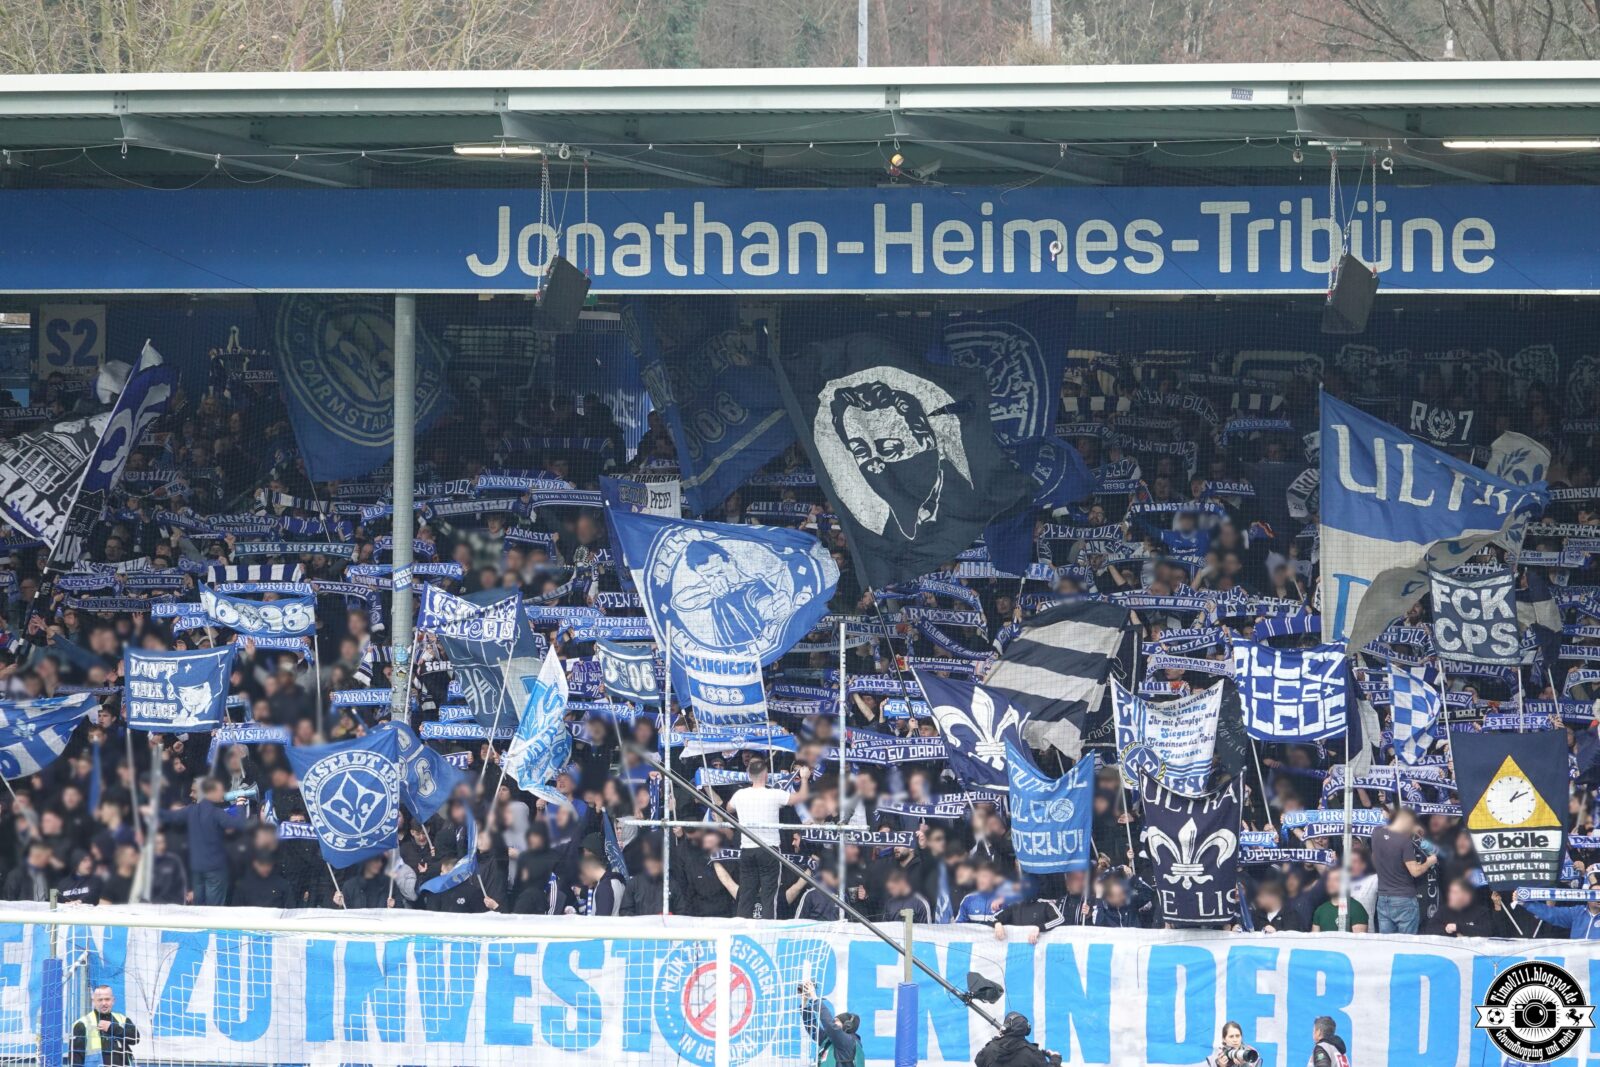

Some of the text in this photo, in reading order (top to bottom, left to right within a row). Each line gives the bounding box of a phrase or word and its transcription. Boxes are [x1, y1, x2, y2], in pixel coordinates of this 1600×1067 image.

[466, 197, 1496, 277] Jonathan-Heimes-Tribüne
[46, 318, 99, 366] S2
[1144, 502, 1199, 513] DARMSTADT
[1204, 503, 1215, 512] 98
[244, 543, 281, 553] USUAL
[147, 577, 163, 585] DIE
[1161, 598, 1175, 607] AM
[1431, 579, 1516, 621] FCK
[1435, 617, 1520, 656] CPS
[1156, 655, 1226, 670] DARMSTADT 98
[1233, 646, 1346, 686] ALLEZ
[333, 689, 392, 702] DARMSTA
[790, 686, 830, 698] TRADITION
[1252, 677, 1322, 702] LES
[131, 701, 178, 718] POLICE
[1205, 709, 1217, 718] und
[895, 738, 914, 746] DIE
[887, 746, 905, 761] SV
[304, 752, 380, 827] DARMSTADT
[862, 832, 881, 843] DE
[886, 832, 907, 844] LIS
[1497, 832, 1549, 848] bölle
[1531, 851, 1542, 860] AM
[1513, 872, 1525, 881] DE
[1532, 872, 1550, 881] LIS
[661, 956, 687, 993] NEIN
[154, 929, 273, 1043] ZU
[1004, 942, 1114, 1064] IN
[1147, 945, 1355, 1067] DER
[678, 1032, 696, 1054] IN
